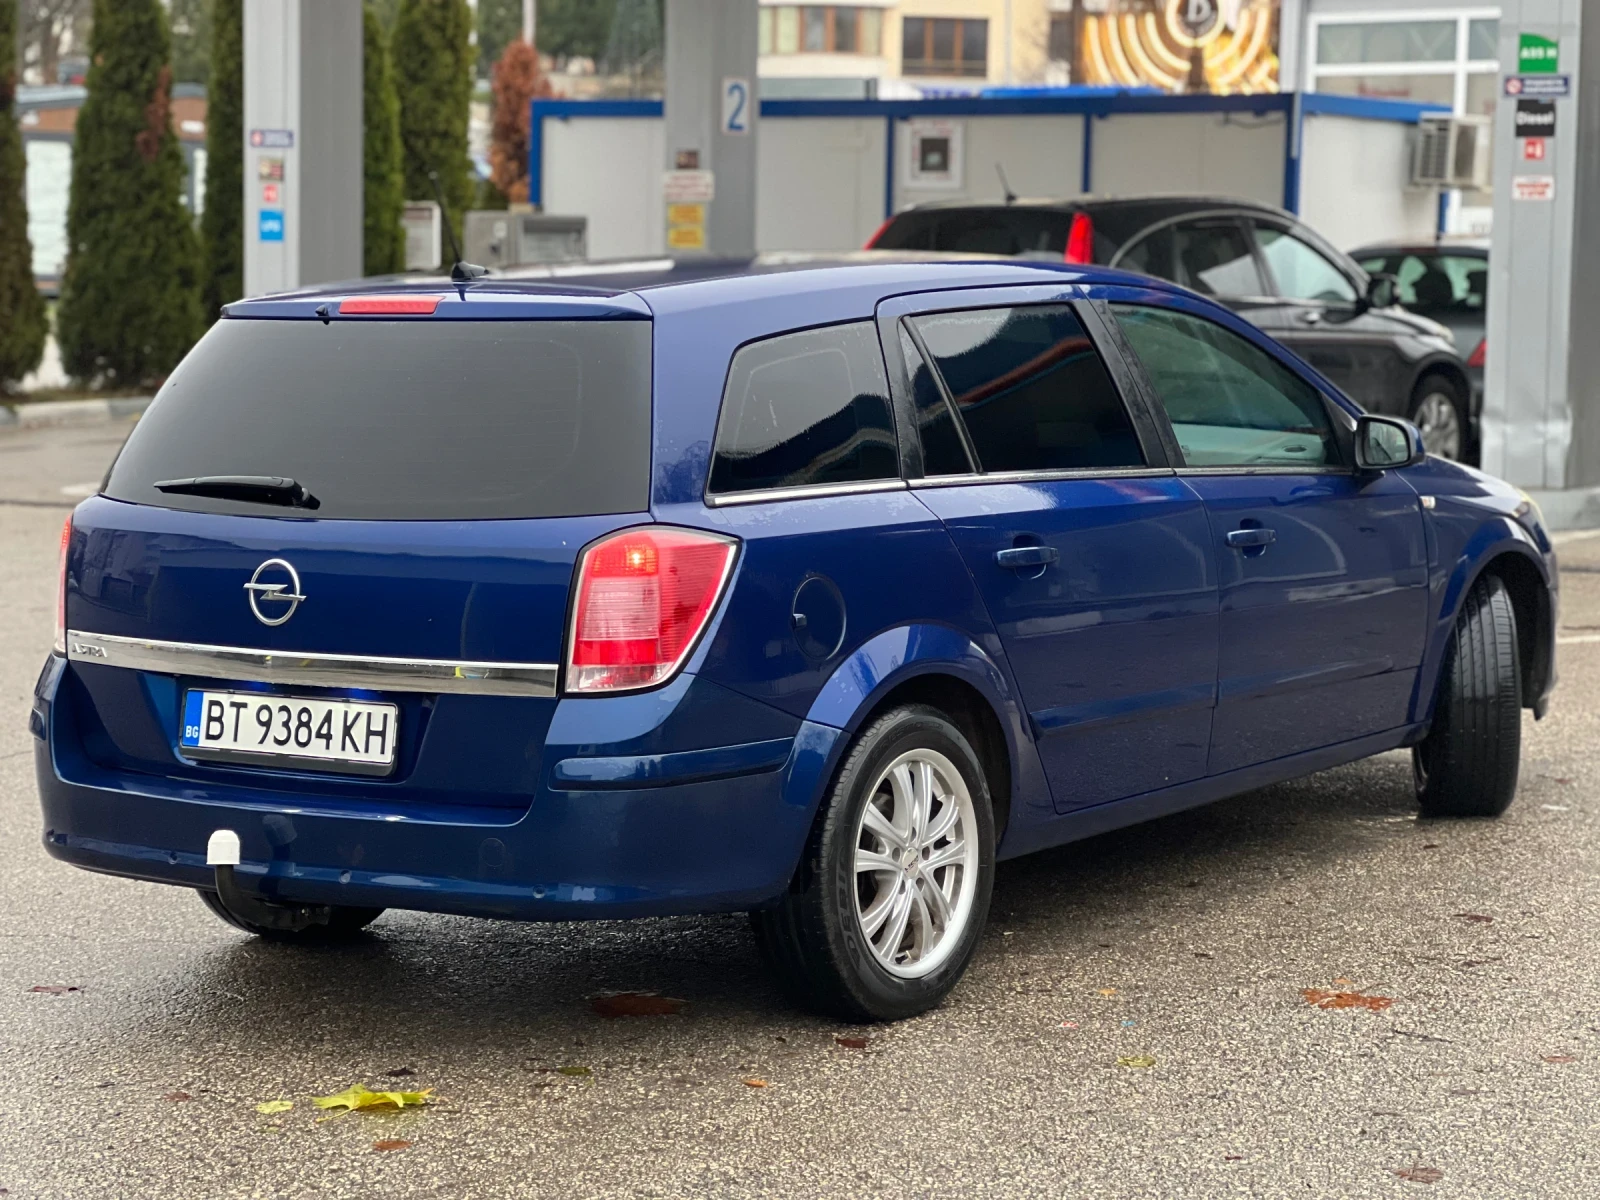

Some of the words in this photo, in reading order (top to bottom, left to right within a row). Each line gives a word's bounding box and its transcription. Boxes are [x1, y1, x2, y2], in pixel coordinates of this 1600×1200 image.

[727, 83, 746, 131] 2
[1516, 111, 1554, 126] Diesel
[72, 642, 108, 658] ASTRA
[185, 725, 199, 739] BG
[205, 699, 248, 743] BT
[255, 703, 333, 751] 9384
[341, 709, 388, 755] KH
